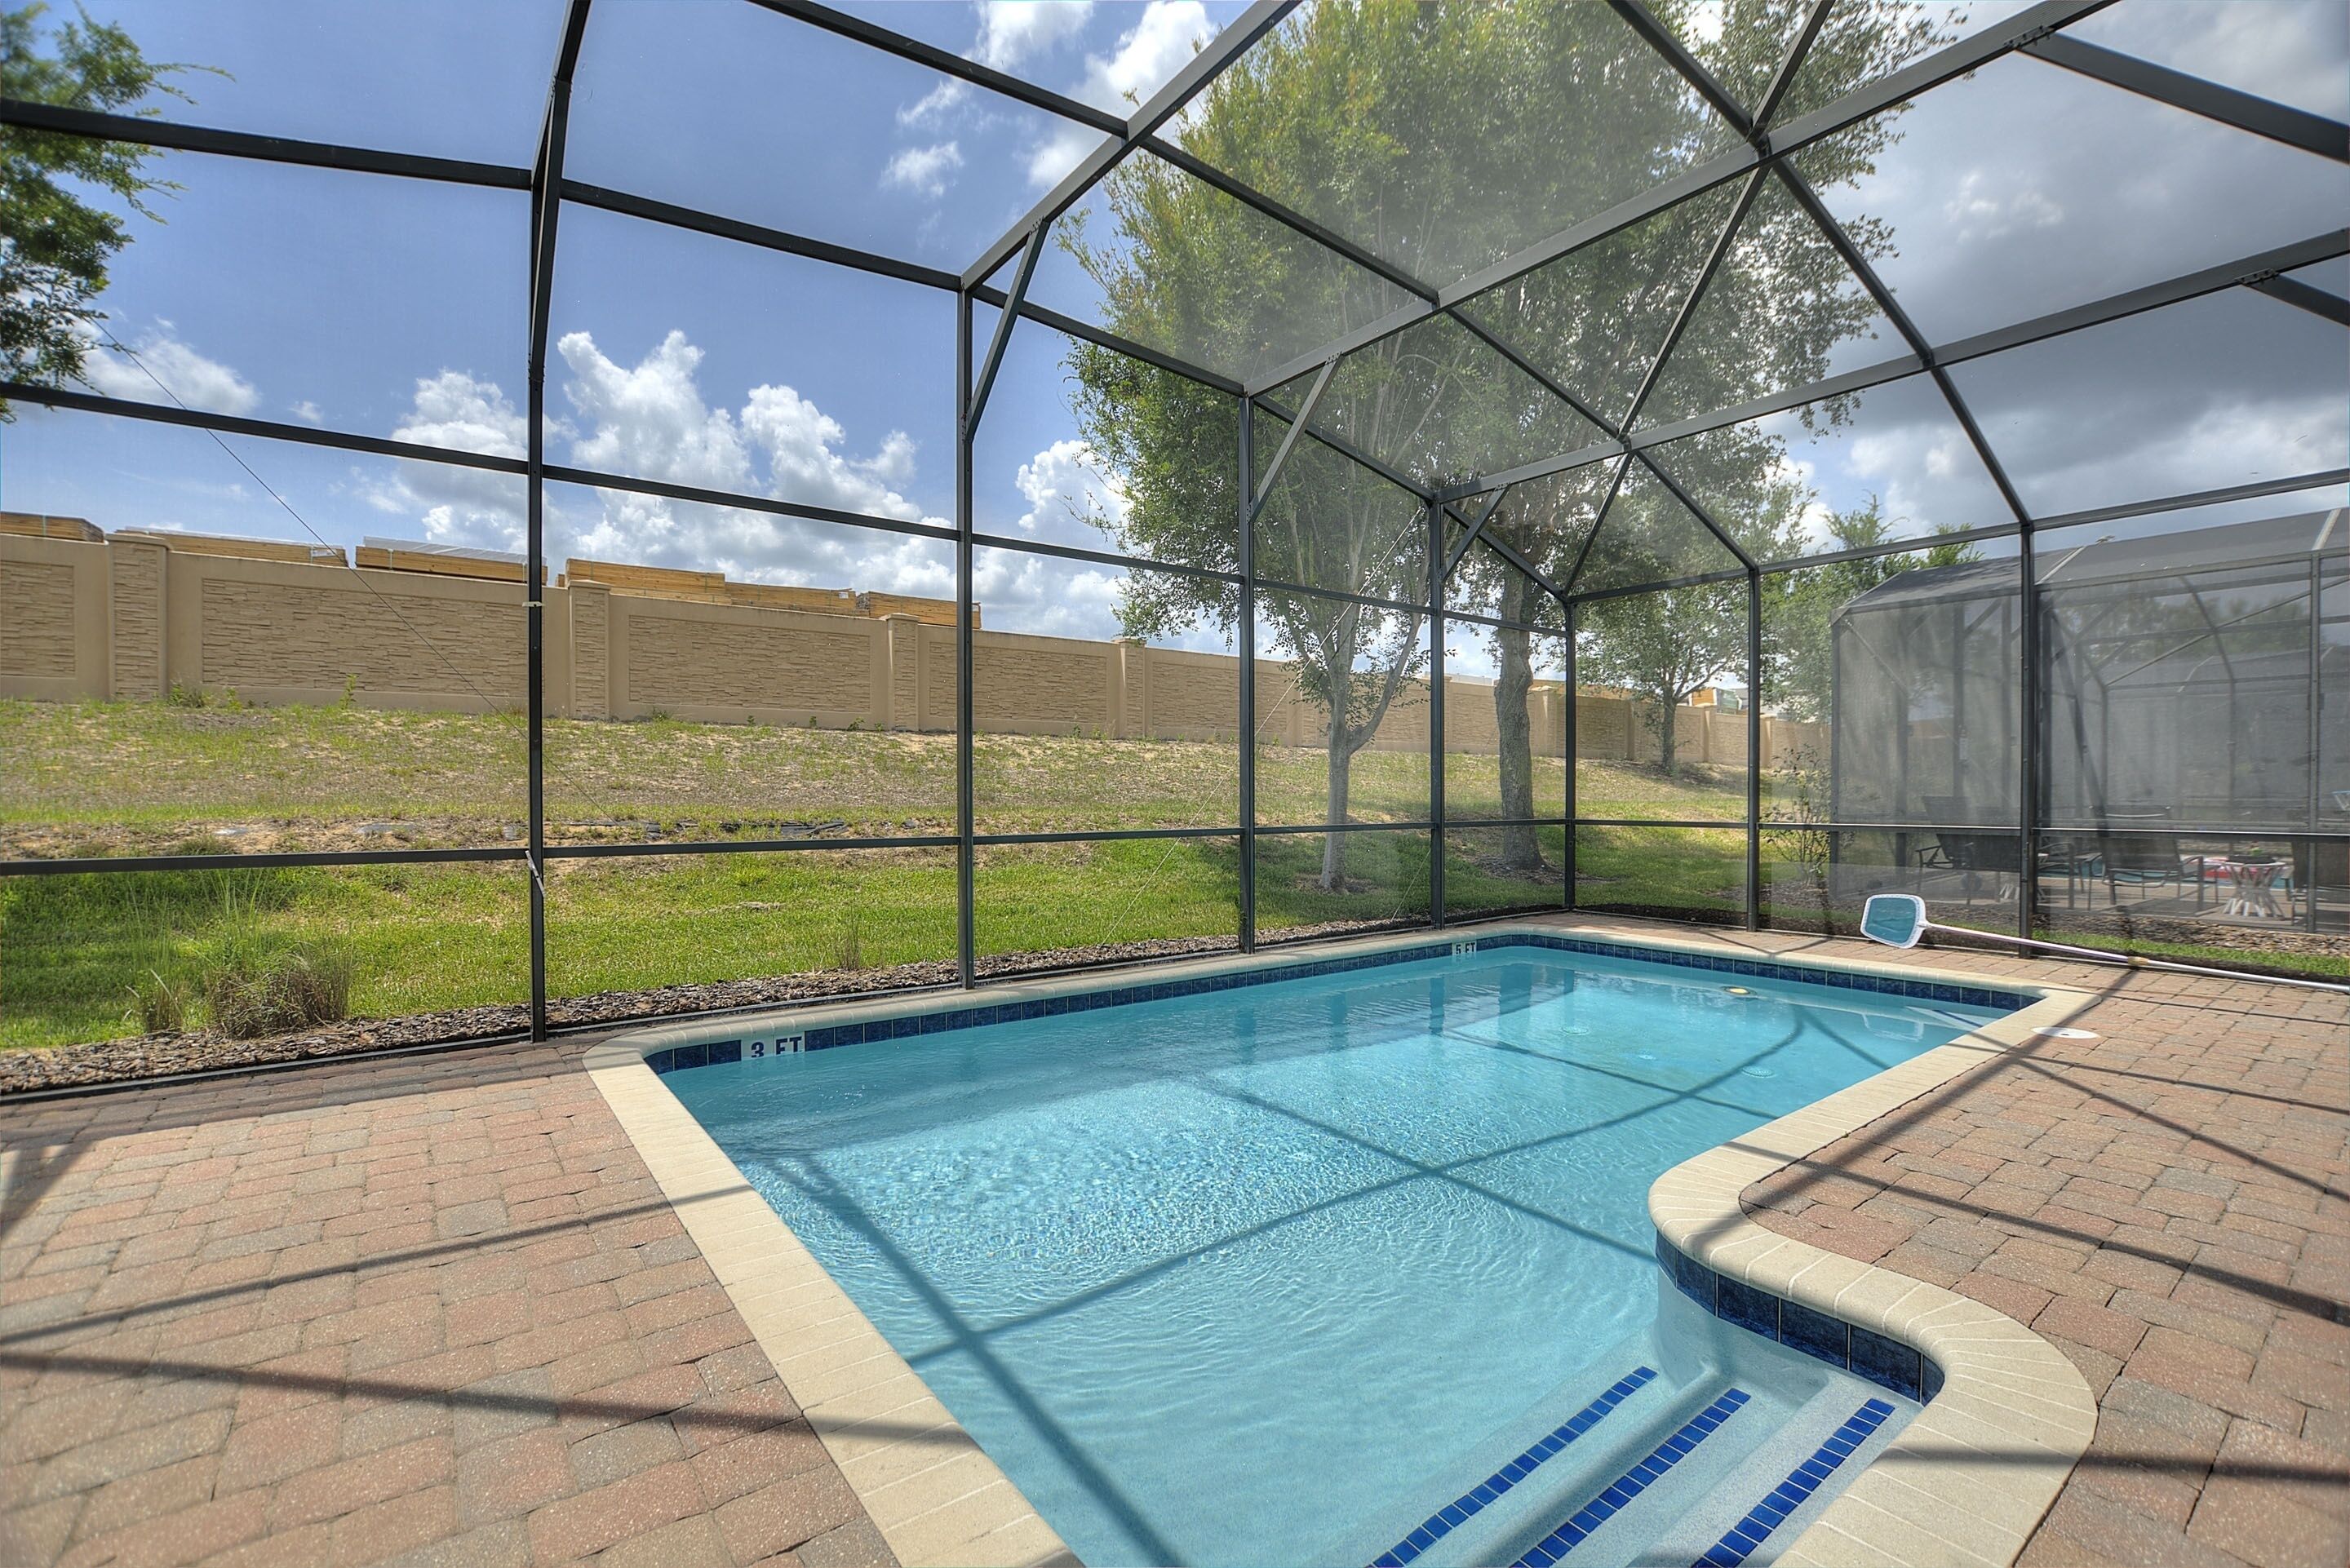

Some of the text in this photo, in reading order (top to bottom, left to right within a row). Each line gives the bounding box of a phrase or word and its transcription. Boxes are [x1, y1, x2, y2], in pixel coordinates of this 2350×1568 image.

[1456, 942, 1476, 955] 5 FT
[751, 1036, 802, 1058] 3 FT
